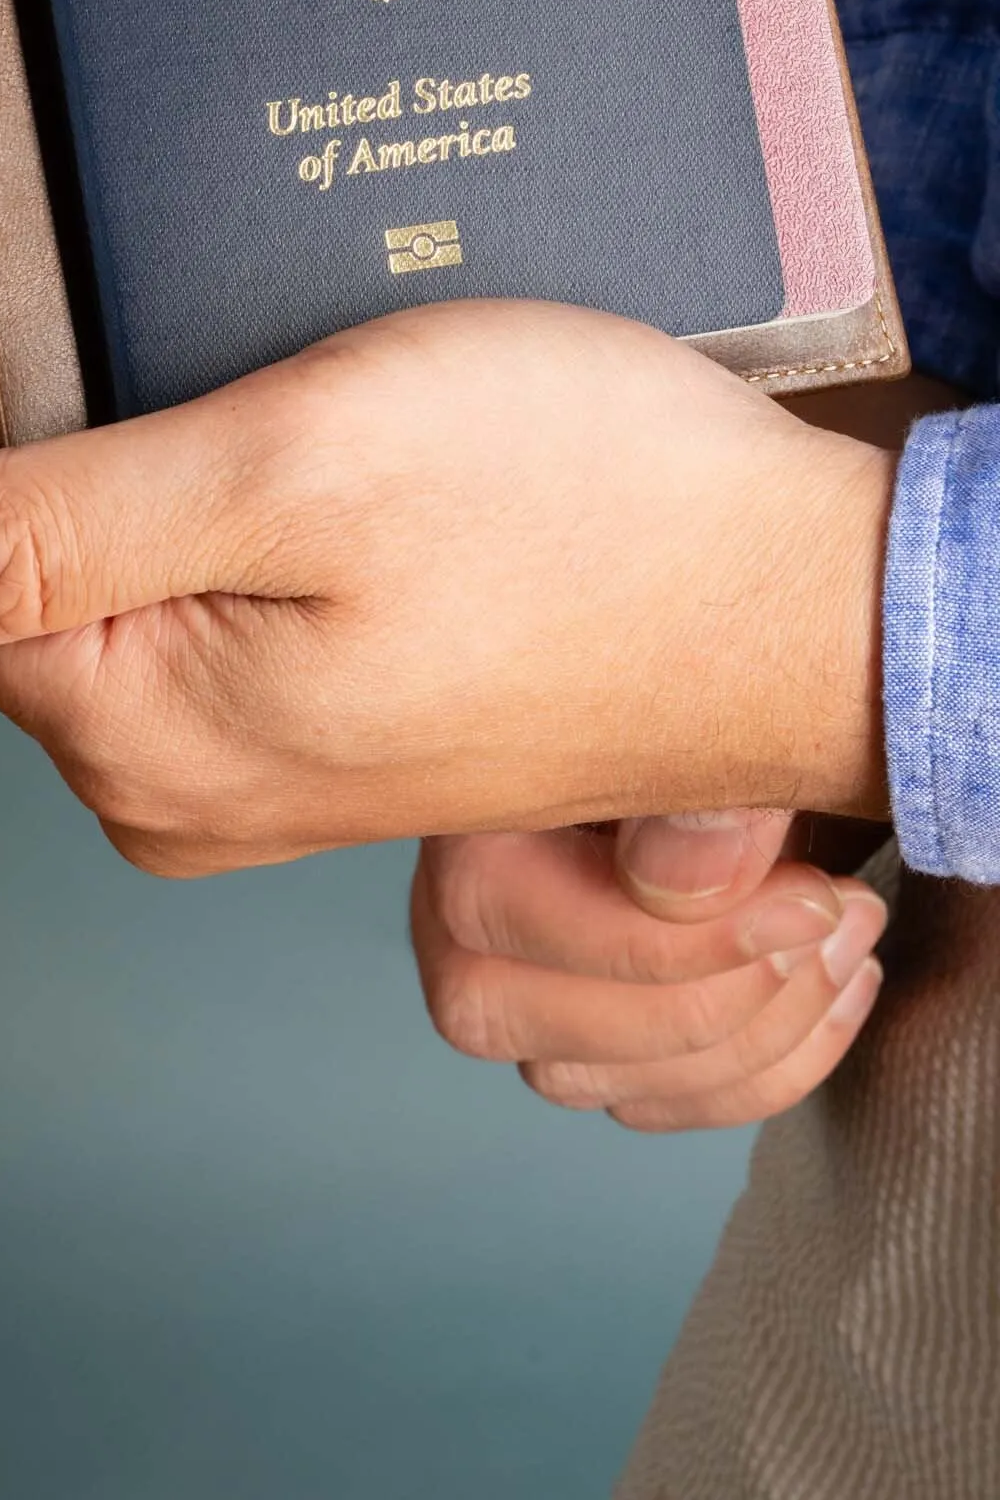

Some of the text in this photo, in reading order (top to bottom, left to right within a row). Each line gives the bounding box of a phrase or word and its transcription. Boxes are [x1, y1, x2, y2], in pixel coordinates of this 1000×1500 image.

[266, 70, 533, 137] United States
[298, 120, 517, 191] of America
